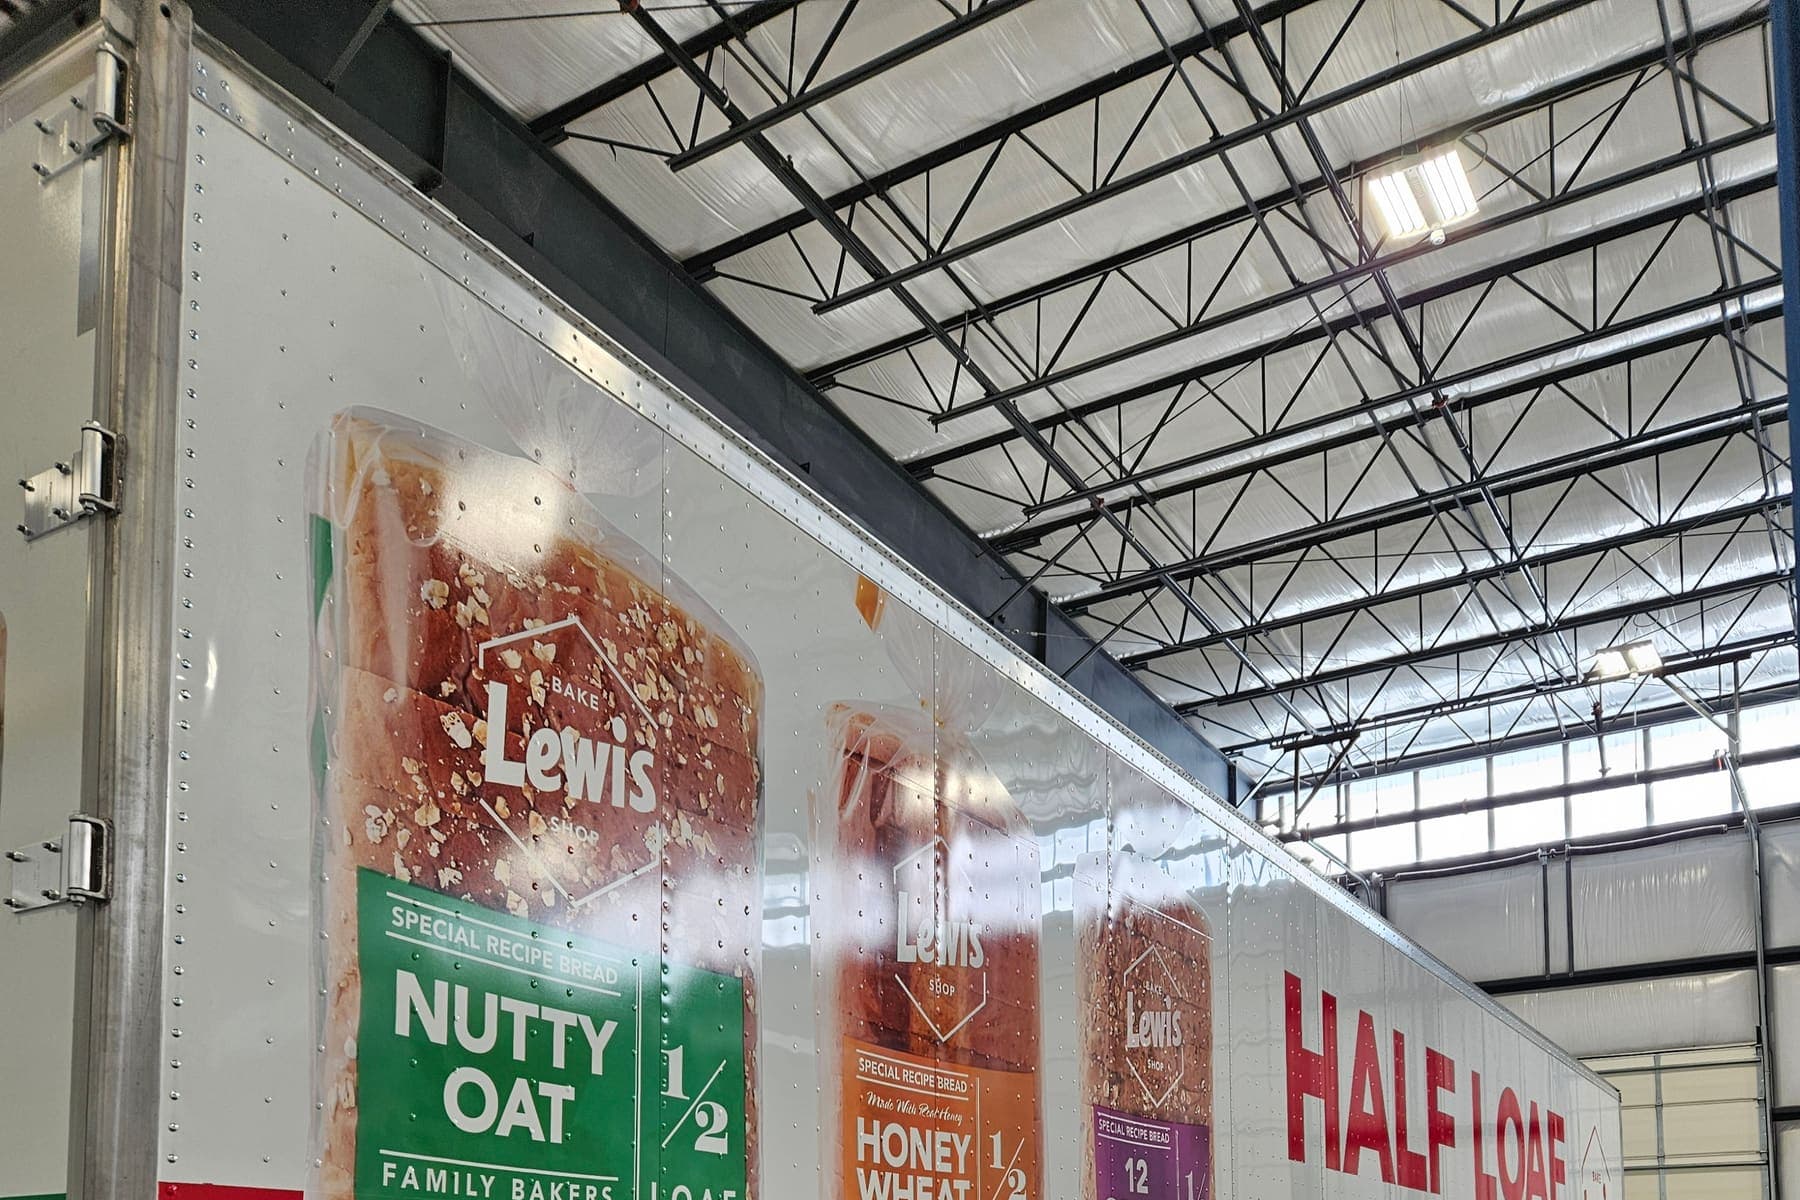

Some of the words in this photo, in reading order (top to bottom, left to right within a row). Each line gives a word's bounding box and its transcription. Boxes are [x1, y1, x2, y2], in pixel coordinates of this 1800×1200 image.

[551, 676, 600, 711] BAKE
[484, 681, 657, 814] Lewis
[550, 816, 600, 847] SHOP
[391, 907, 480, 950] SPECIAL
[486, 934, 553, 969] RECIPE
[559, 957, 619, 985] BREAD
[897, 891, 984, 968] Lewis
[928, 979, 955, 996] SHOP
[395, 968, 619, 1076] NUTTY
[1126, 991, 1182, 1049] Lewis
[858, 1057, 900, 1081] SPECIAL
[902, 1068, 935, 1088] RECIPE
[937, 1075, 968, 1093] BREAD
[1284, 969, 1456, 1195] HALF
[443, 1066, 575, 1144] OAT
[867, 1091, 894, 1111] Made
[896, 1099, 917, 1115] With
[857, 1116, 971, 1174] HONEY
[1098, 1118, 1125, 1137] SPECIAL
[1126, 1124, 1148, 1140] RECIPE
[1149, 1130, 1170, 1144] BREAD
[382, 1162, 496, 1198] FAMILY
[1125, 1157, 1149, 1194] 12
